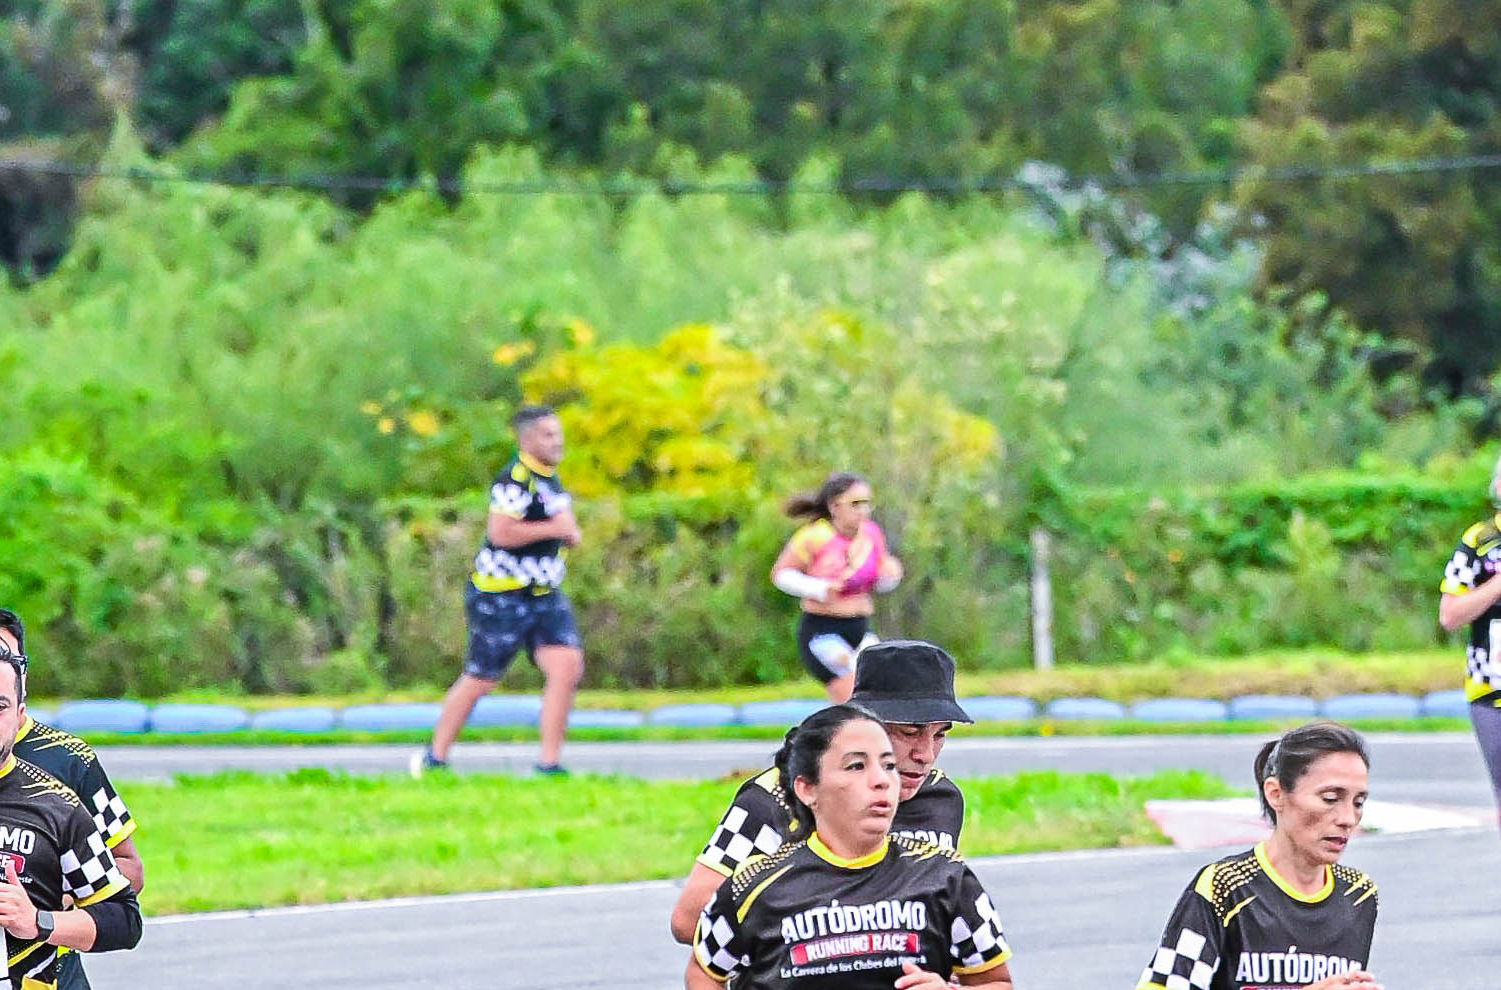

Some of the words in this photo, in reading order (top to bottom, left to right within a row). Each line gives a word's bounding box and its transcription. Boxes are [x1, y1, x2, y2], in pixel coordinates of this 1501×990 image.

[781, 899, 927, 944] AUTÓDROMO
[805, 936, 870, 961] RUNNING
[872, 934, 908, 951] RACE
[792, 966, 826, 977] Carrera
[826, 964, 838, 974] de
[839, 962, 853, 972] los
[853, 959, 883, 971] Clubes
[884, 957, 898, 968] del
